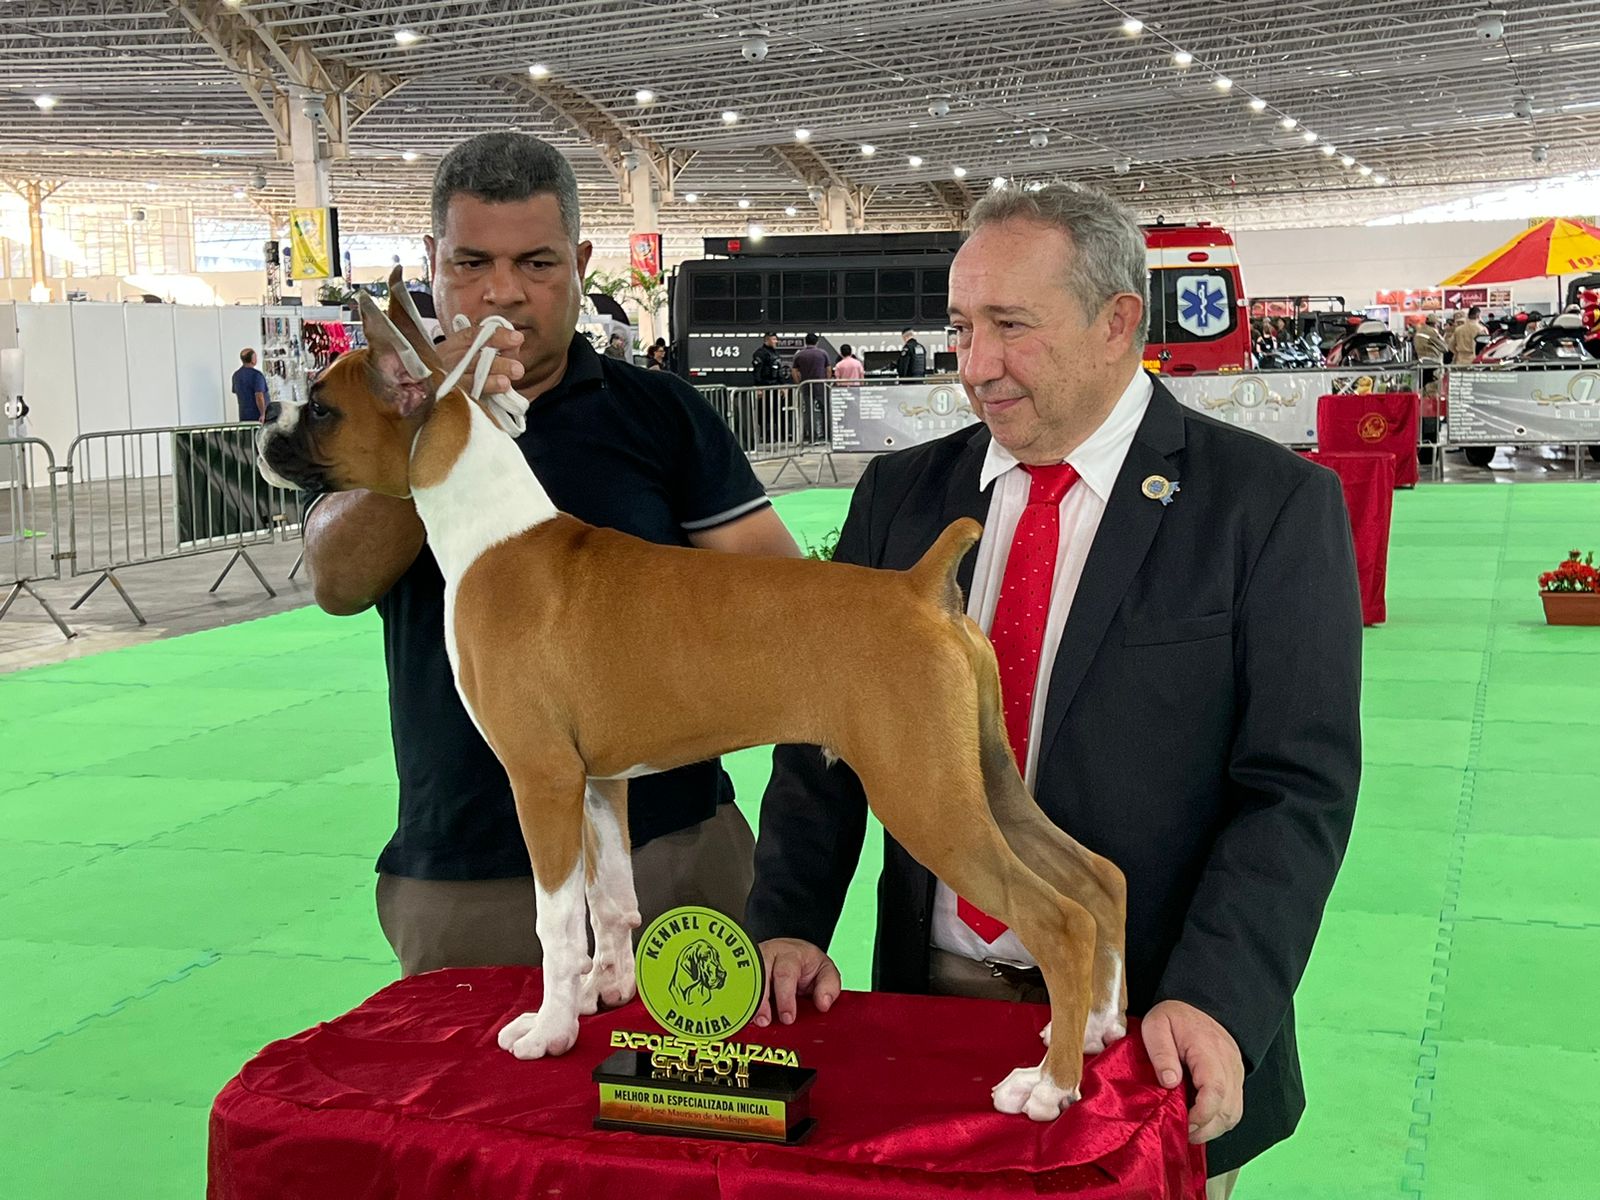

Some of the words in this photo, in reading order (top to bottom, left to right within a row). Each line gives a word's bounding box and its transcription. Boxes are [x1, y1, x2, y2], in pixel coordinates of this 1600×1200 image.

[709, 345, 740, 358] 1643
[937, 392, 949, 413] 9
[1243, 383, 1256, 405] 8
[645, 915, 700, 960] KENNEL
[708, 921, 750, 968] CLUBE
[665, 1008, 732, 1035] PARAÍBA
[651, 1051, 733, 1076] GRUPO
[614, 1089, 650, 1103] MELHOR
[652, 1093, 665, 1105] DA
[667, 1094, 734, 1112] ESPECIALIZADA
[736, 1102, 770, 1116] INICIAL
